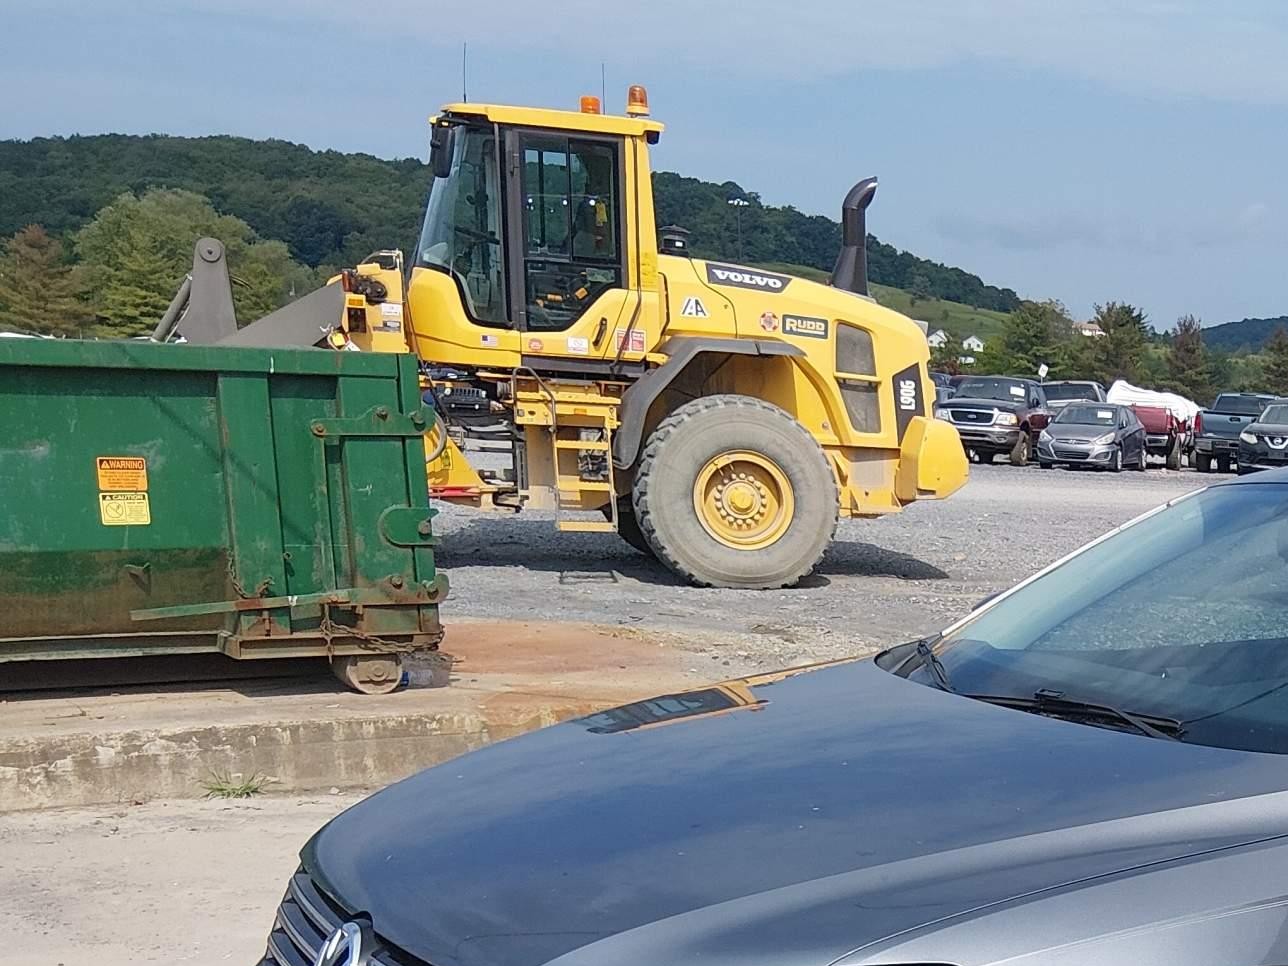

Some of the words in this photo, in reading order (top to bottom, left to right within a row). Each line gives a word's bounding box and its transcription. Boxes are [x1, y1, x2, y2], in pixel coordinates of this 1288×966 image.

[711, 268, 783, 289] VOLVO
[785, 317, 826, 335] RUDD
[899, 380, 916, 411] L90G
[109, 460, 143, 469] WARNING
